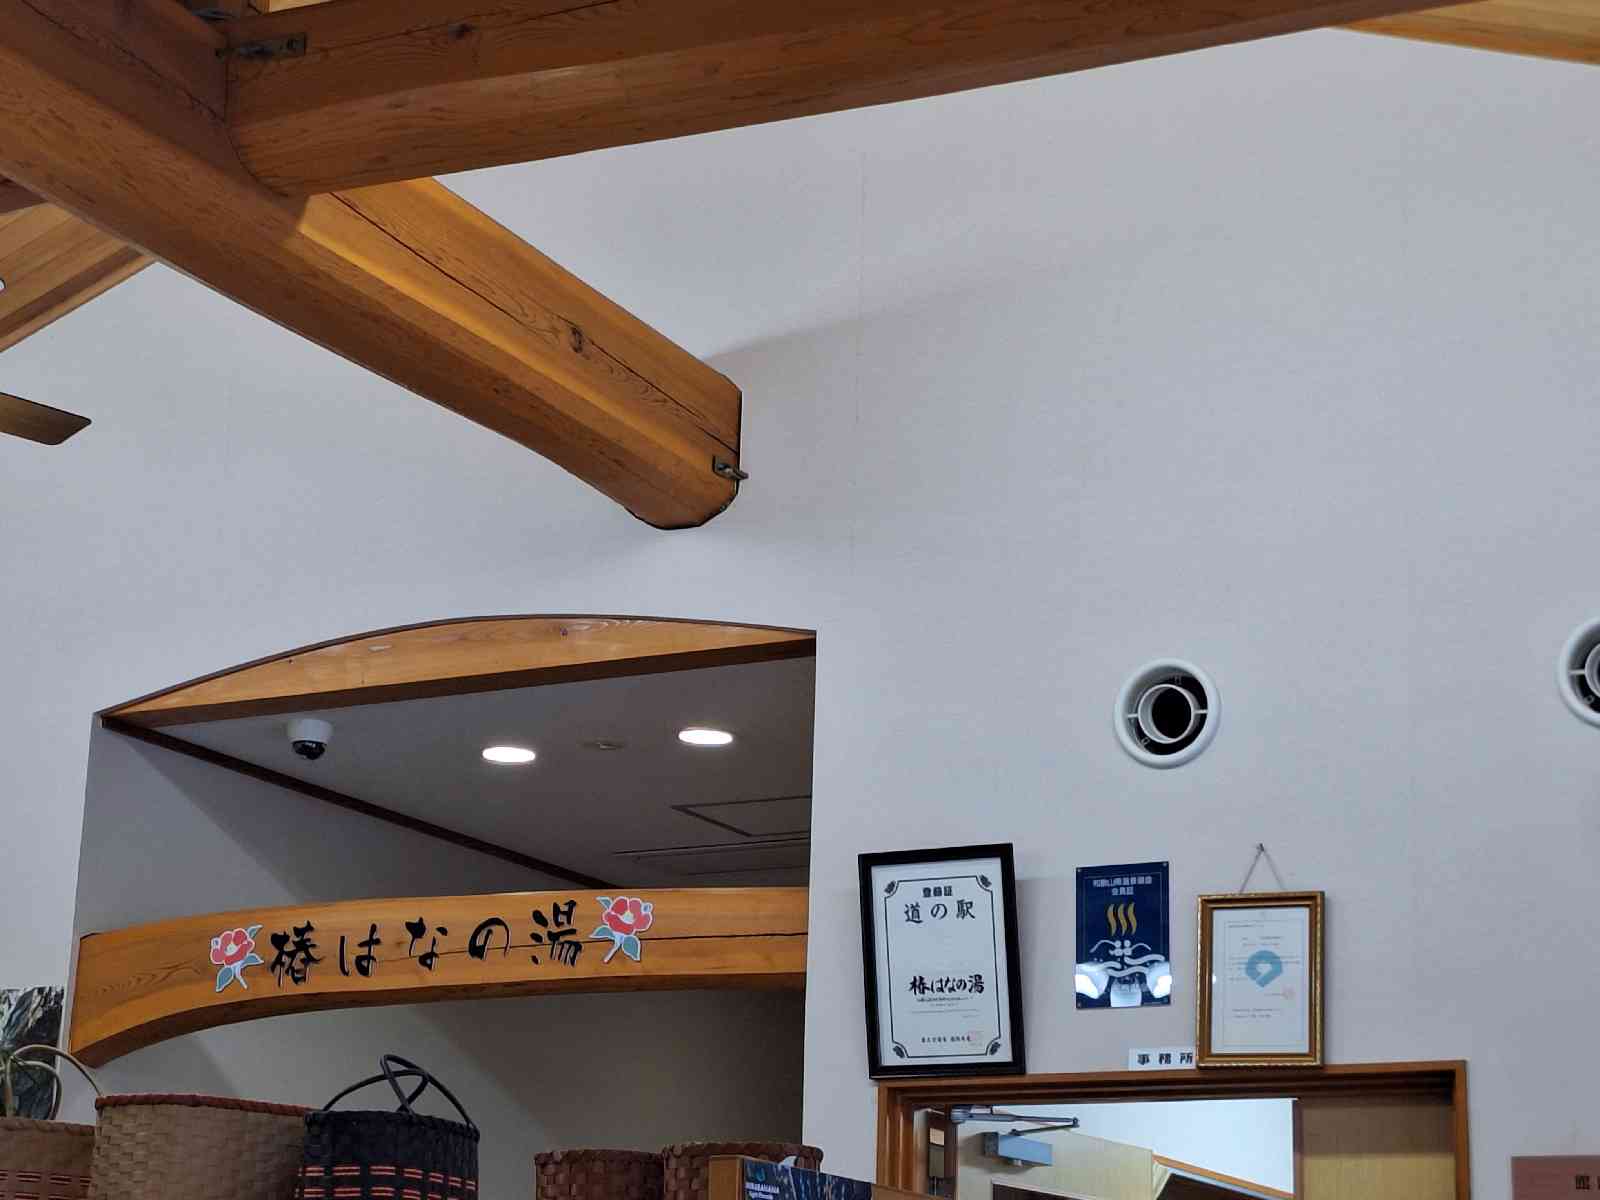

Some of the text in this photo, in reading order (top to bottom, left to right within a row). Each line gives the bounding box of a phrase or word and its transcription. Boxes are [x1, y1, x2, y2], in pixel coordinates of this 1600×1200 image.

[904, 899, 976, 924] 道の駅
[270, 900, 582, 988] 椿はなの湯
[909, 974, 985, 996] 椿はなの湯
[1137, 1052, 1193, 1065] 事務所
